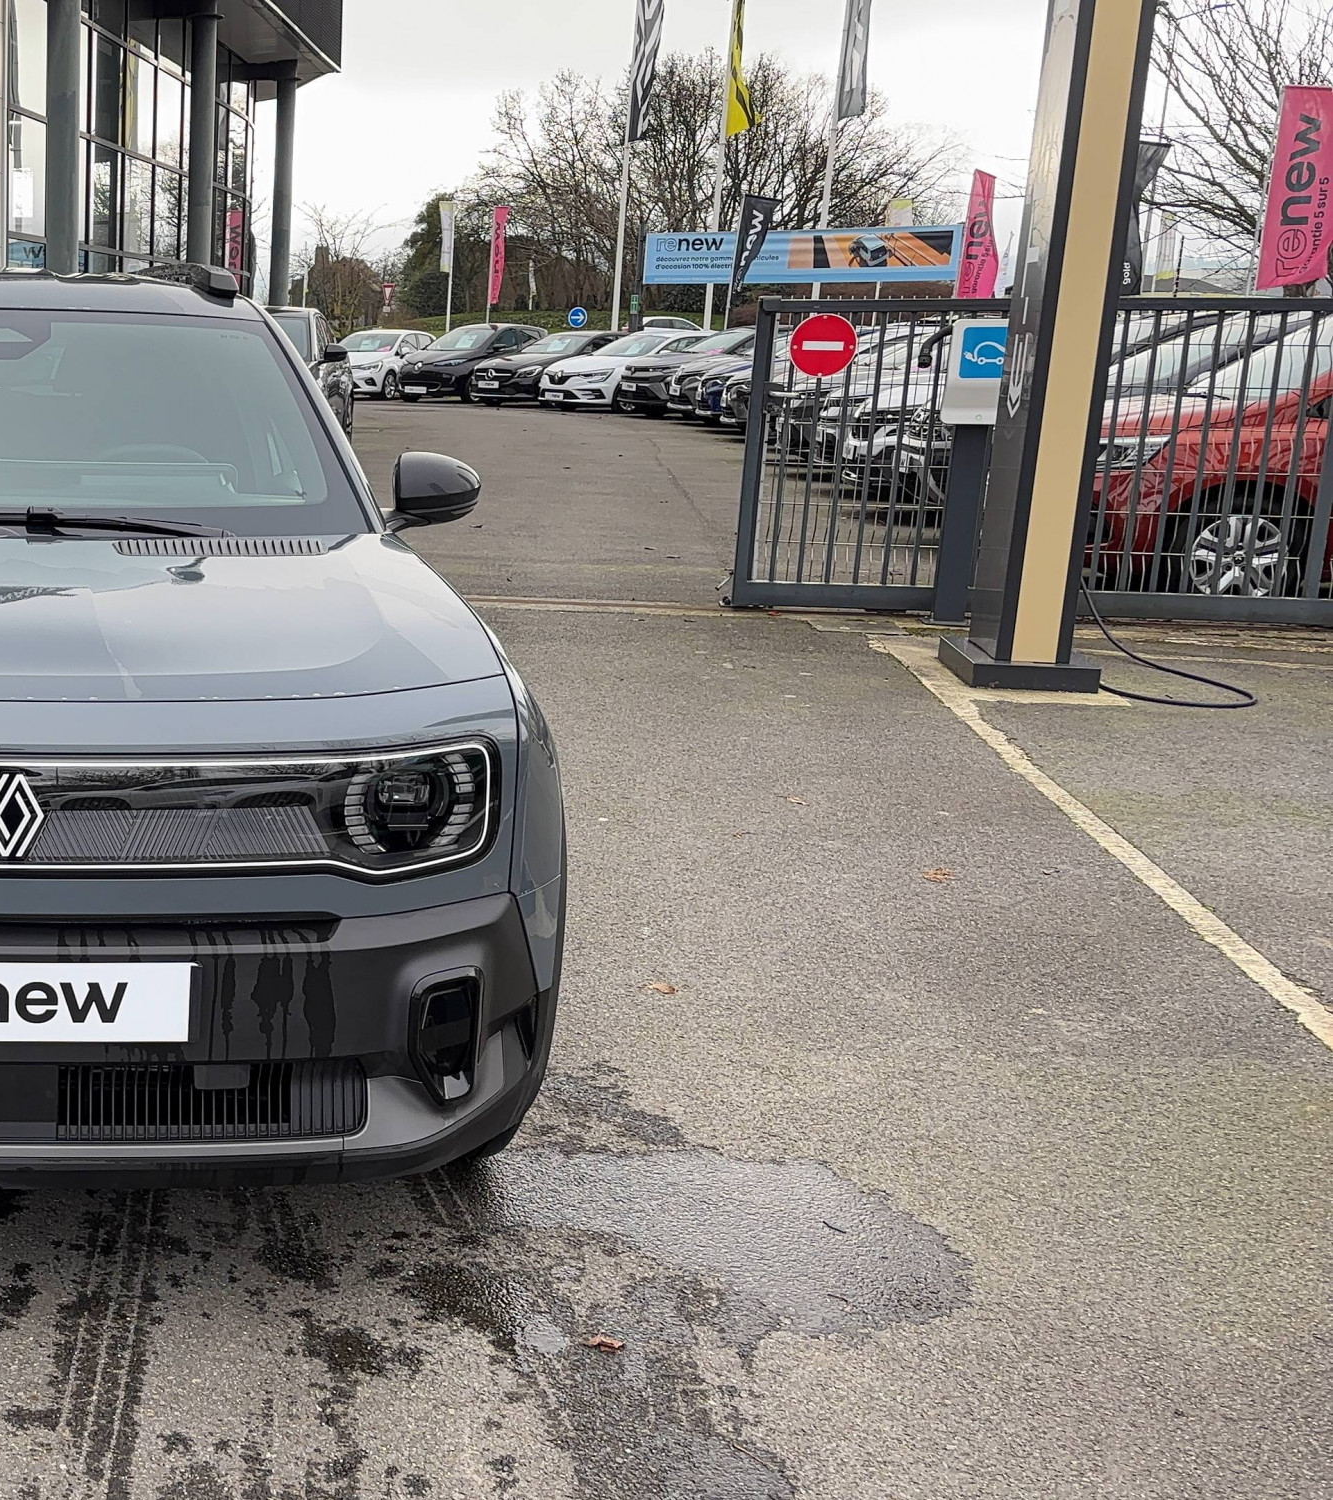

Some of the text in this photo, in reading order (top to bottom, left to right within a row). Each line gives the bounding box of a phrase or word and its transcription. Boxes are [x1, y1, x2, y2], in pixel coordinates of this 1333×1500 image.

[1275, 113, 1322, 278] renew
[1299, 176, 1330, 274] garantie 5 sur 5
[655, 236, 724, 252] renew
[655, 254, 690, 263] découvrez
[655, 262, 691, 270] d'occasion
[710, 262, 733, 270] électri
[1122, 262, 1131, 285] gold
